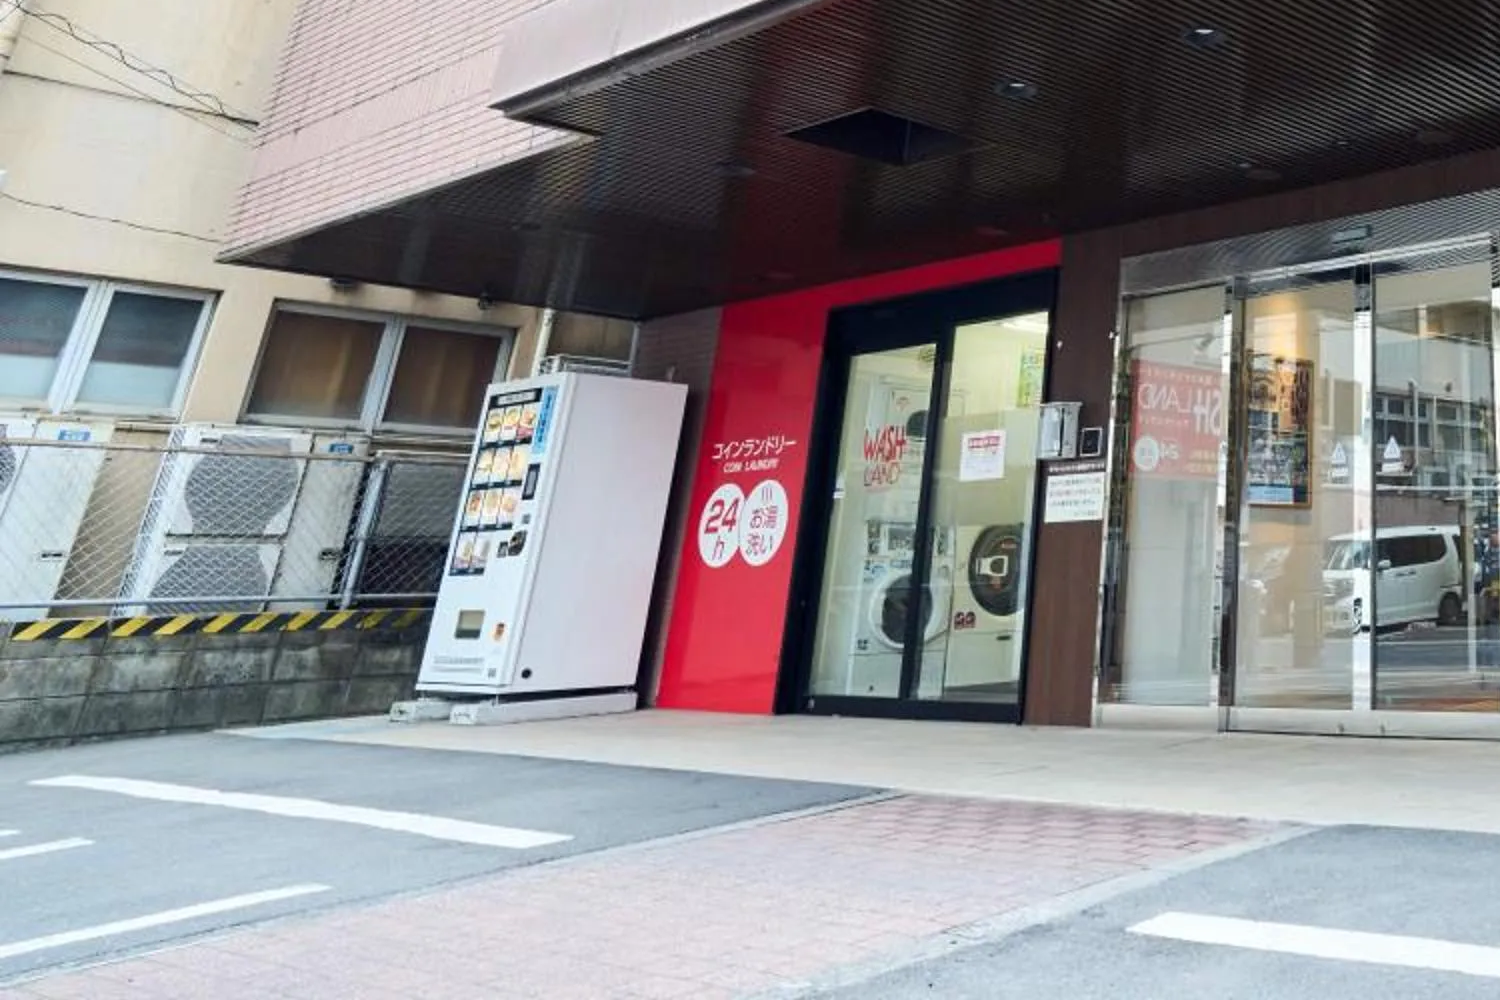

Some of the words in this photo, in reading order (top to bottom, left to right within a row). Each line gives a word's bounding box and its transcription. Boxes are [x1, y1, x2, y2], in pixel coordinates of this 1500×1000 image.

[711, 435, 797, 460] コインランドリー
[863, 424, 907, 463] WASH
[704, 497, 740, 534] 24
